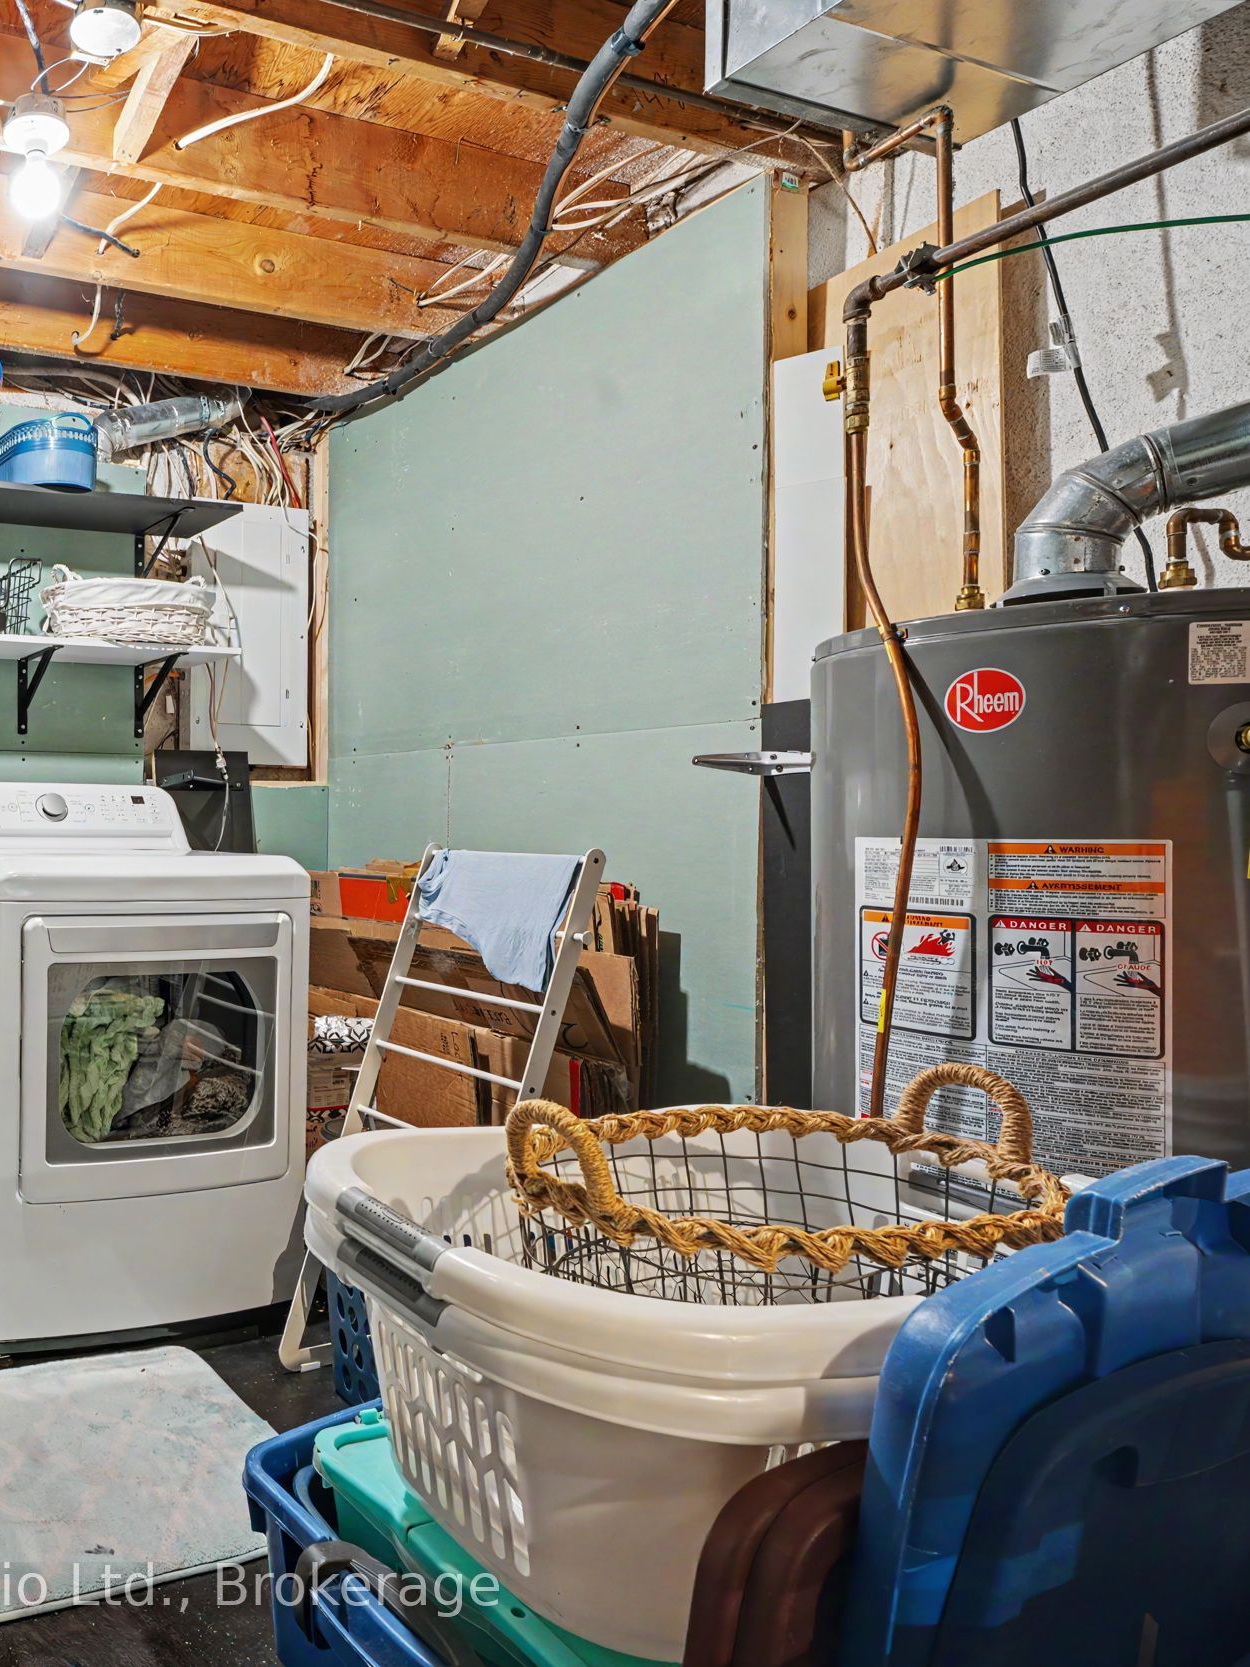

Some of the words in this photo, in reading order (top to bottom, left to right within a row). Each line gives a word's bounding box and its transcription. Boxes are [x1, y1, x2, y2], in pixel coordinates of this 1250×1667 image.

[956, 671, 1020, 723] Rheem
[1059, 845, 1105, 855] WARNING
[1041, 881, 1123, 892] AVERTISSEMENT
[1010, 920, 1067, 931] DANGER
[1096, 924, 1156, 934] DANGER
